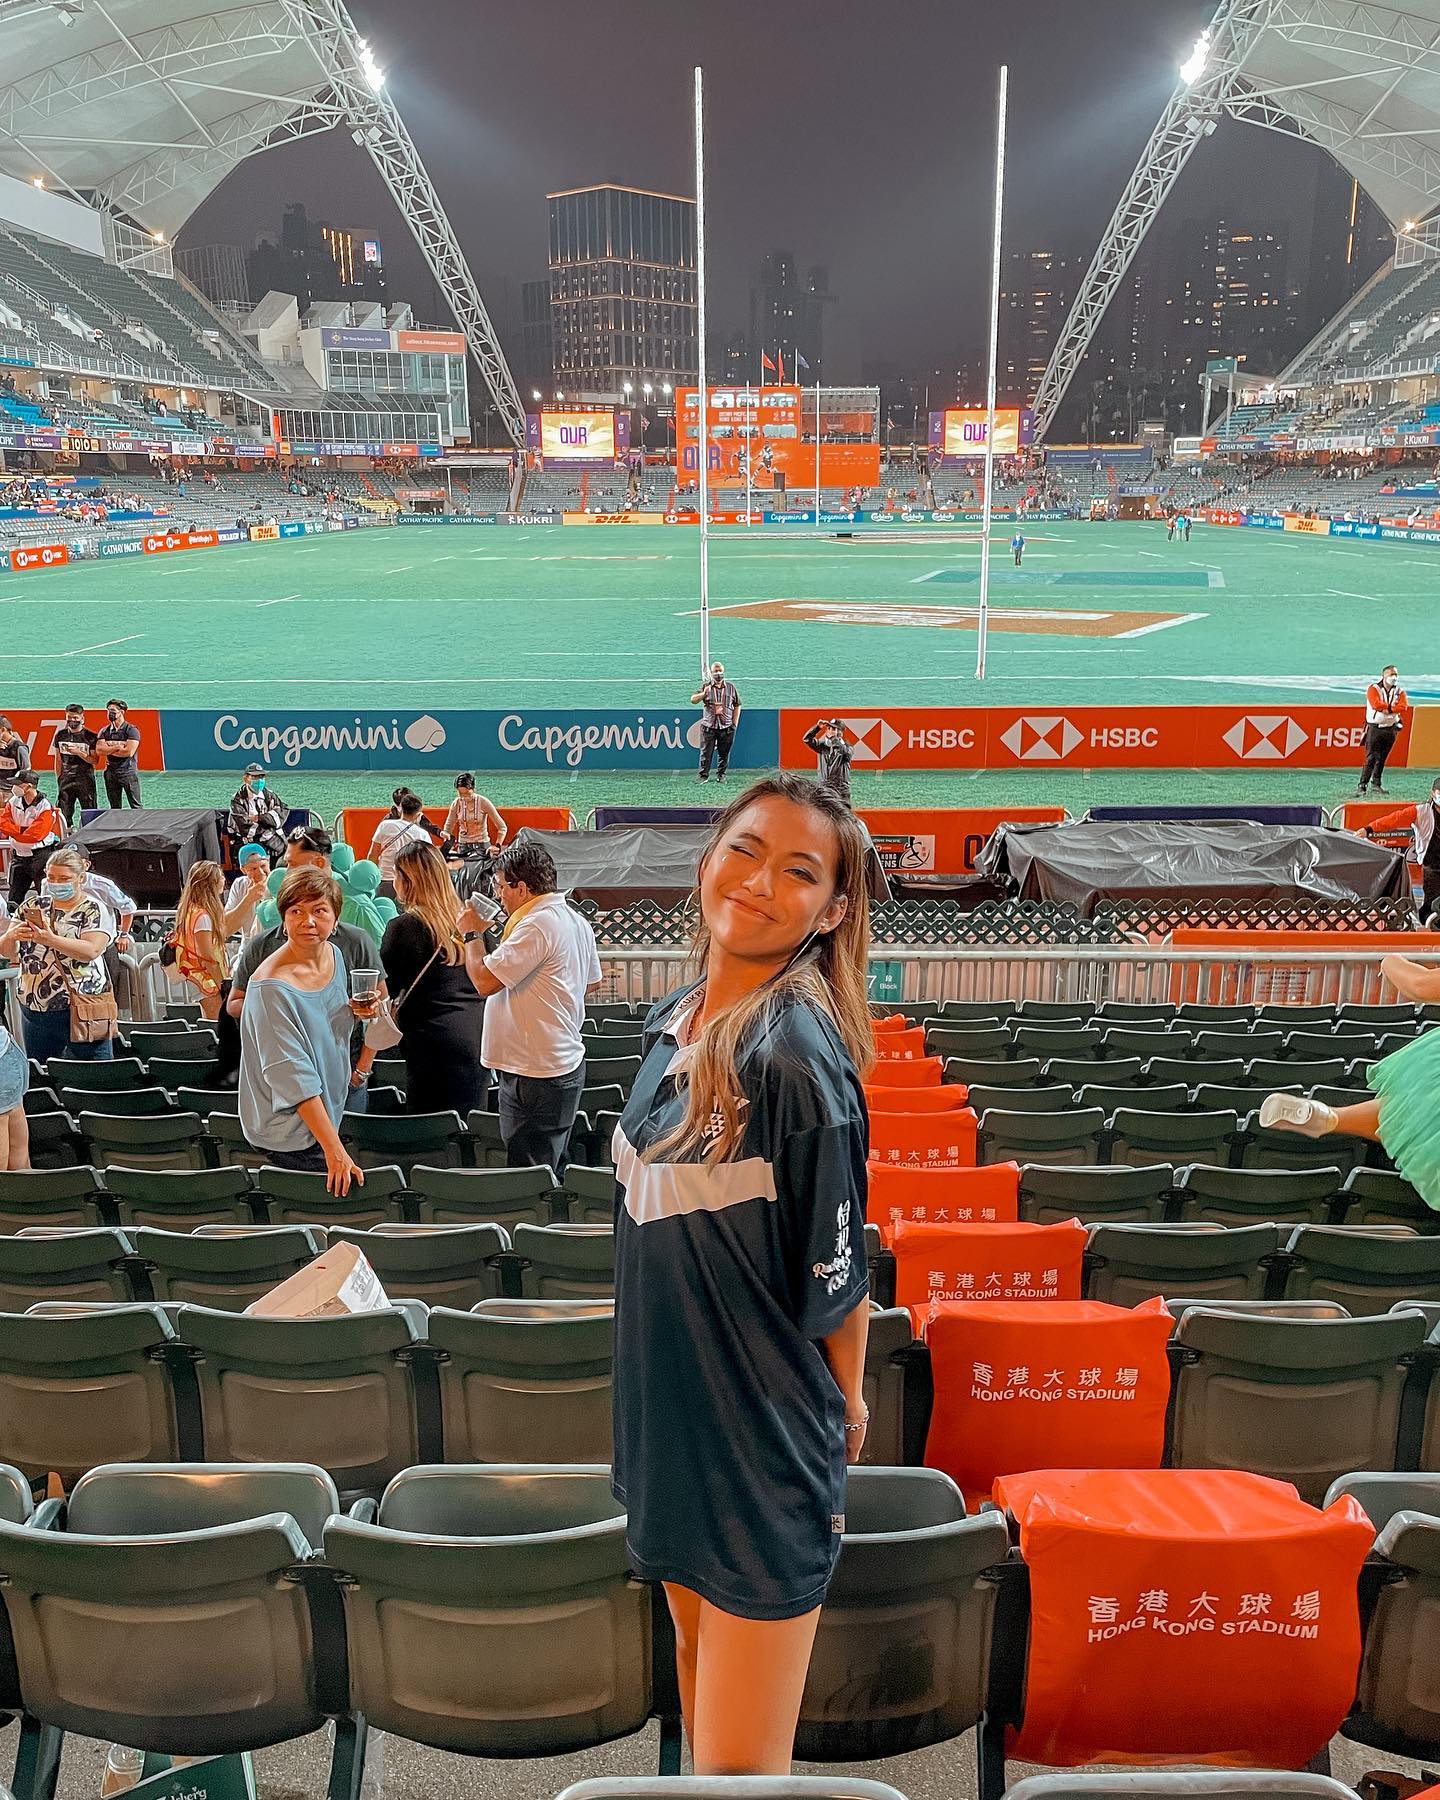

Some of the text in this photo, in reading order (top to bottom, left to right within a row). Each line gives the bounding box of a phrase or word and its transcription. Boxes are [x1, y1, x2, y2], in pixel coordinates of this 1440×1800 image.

[560, 427, 587, 444] OUR
[1409, 436, 1429, 445] KUKRI
[71, 438, 90, 451] 1010
[112, 442, 132, 450] KUKRI
[683, 445, 721, 470] OR
[517, 516, 552, 526] KUKRI
[594, 516, 632, 524] DHL
[770, 514, 802, 523] Capgemini
[214, 715, 402, 766] Capgemini
[498, 715, 684, 766] Capgemini
[908, 730, 974, 749] HSBC
[1090, 728, 1158, 748] HSBC
[1314, 728, 1363, 747] HSB
[922, 1159, 959, 1168] STADIUM
[888, 1206, 996, 1220] 香港大球場
[928, 1269, 1058, 1288] 香港大球場
[928, 1288, 1058, 1300] HONG KONG STADIUM
[972, 1362, 1138, 1388] 香港大球場
[971, 1385, 1136, 1402] HONG KONG STADIUM
[1088, 1590, 1320, 1624] 香港大球場
[1088, 1616, 1318, 1643] HONG KONG STADIUM
